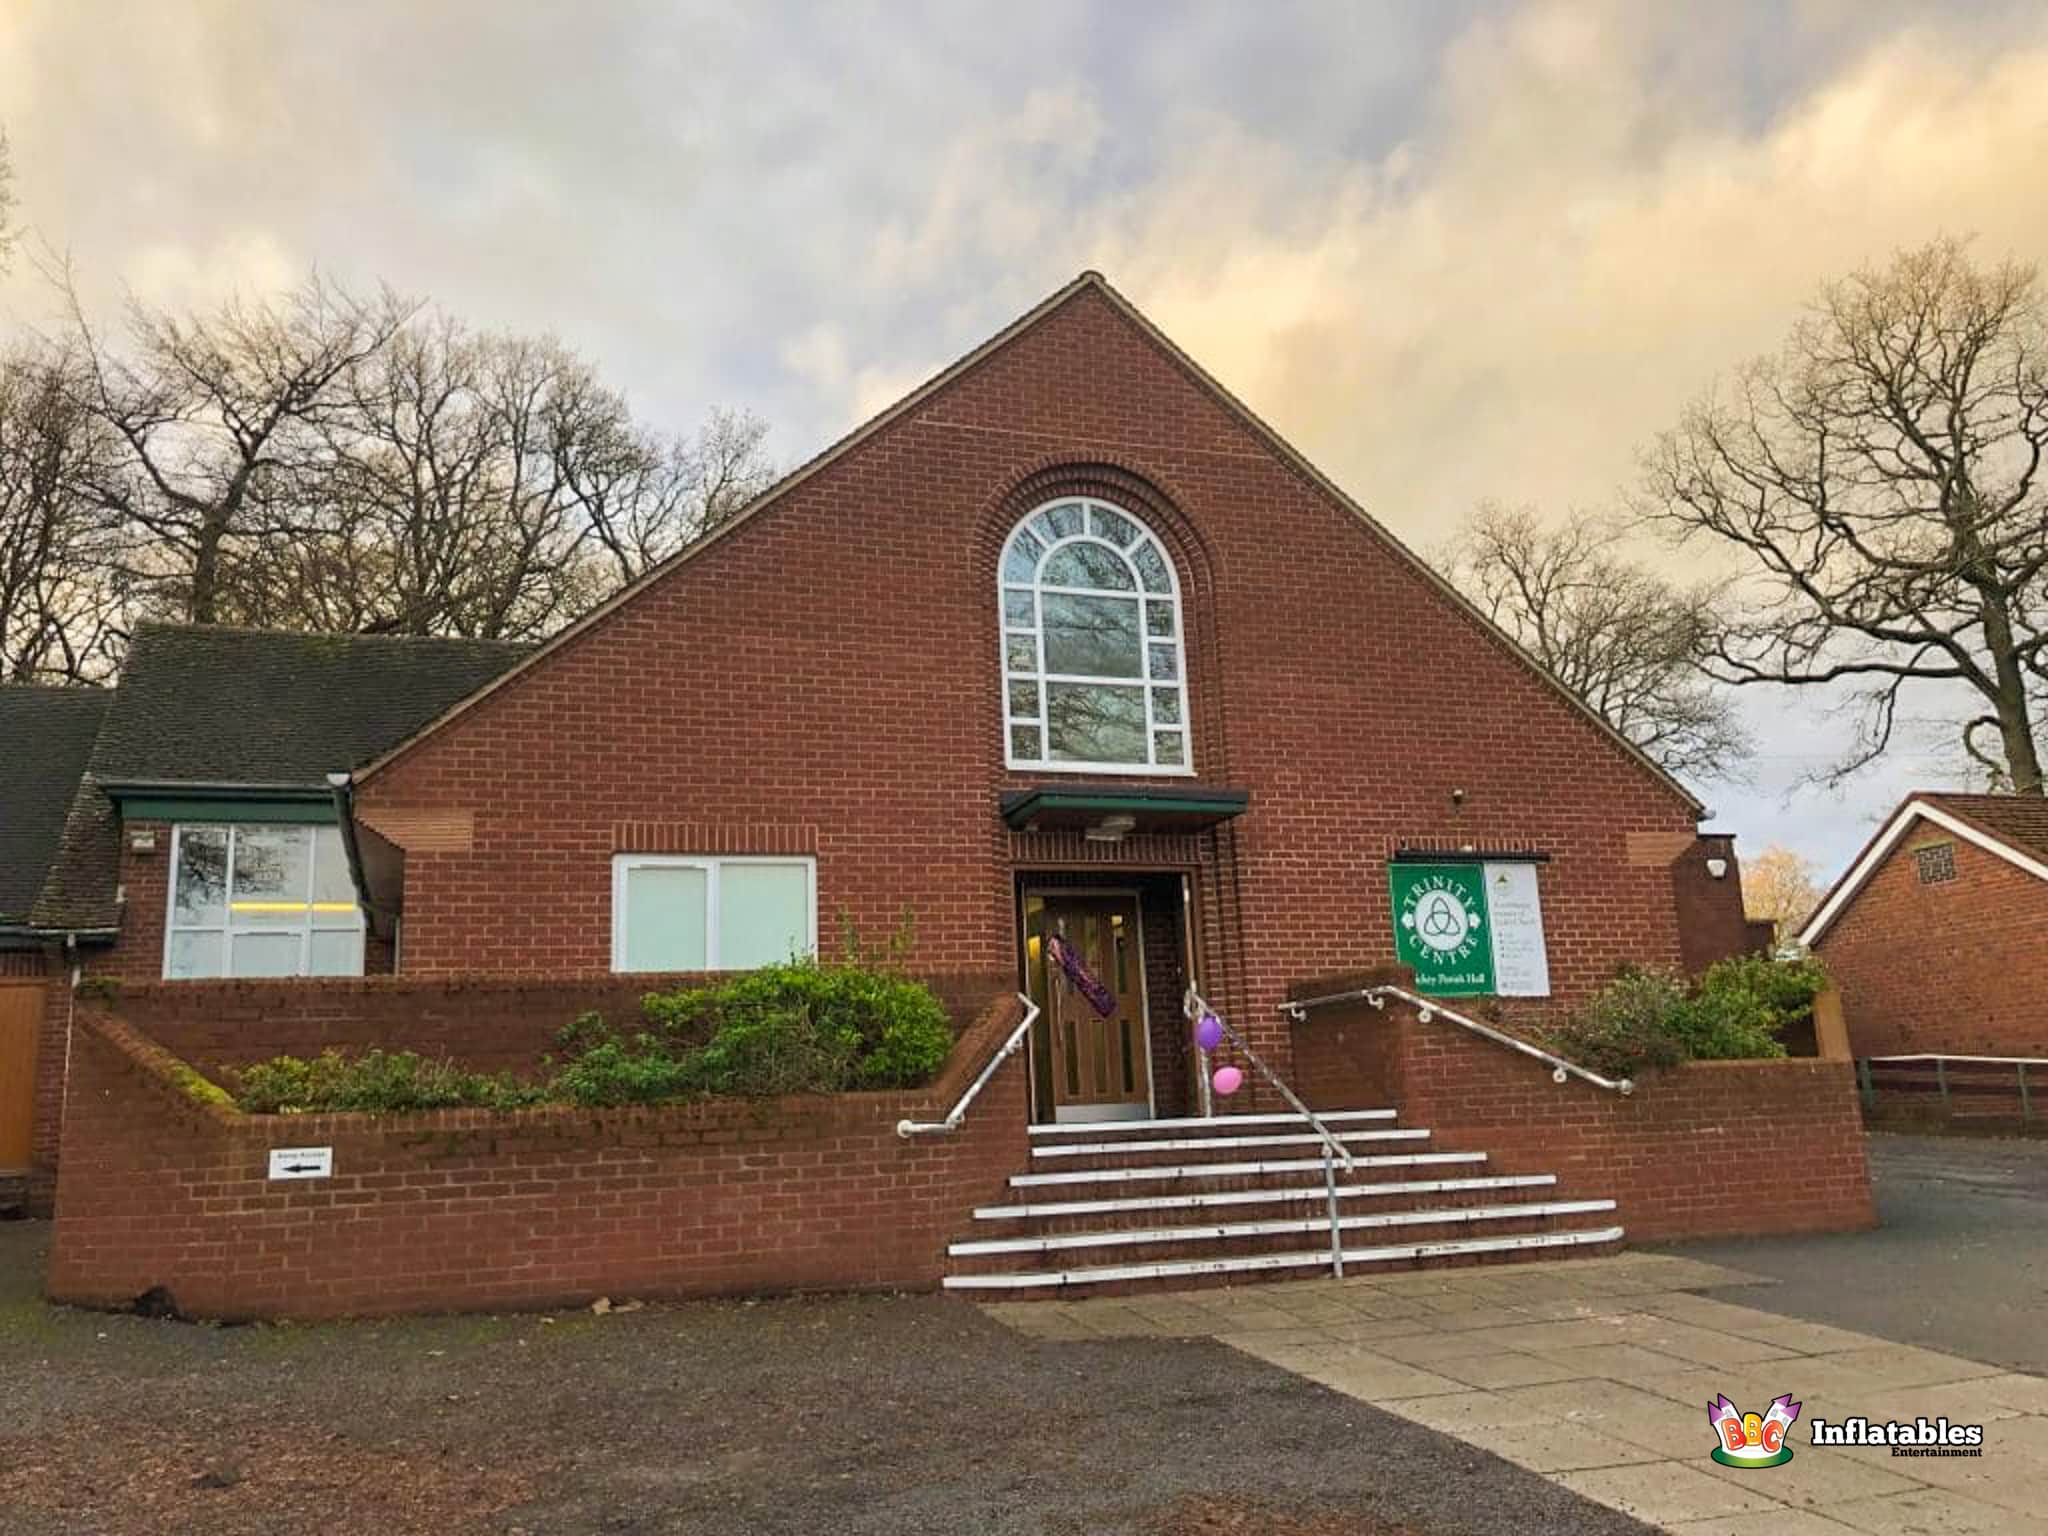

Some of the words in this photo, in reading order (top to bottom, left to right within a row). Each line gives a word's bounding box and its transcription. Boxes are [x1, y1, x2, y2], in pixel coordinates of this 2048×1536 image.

[1403, 875, 1477, 909] TRINITY
[1409, 935, 1478, 966] CENTRE
[1466, 973, 1485, 984] Hall
